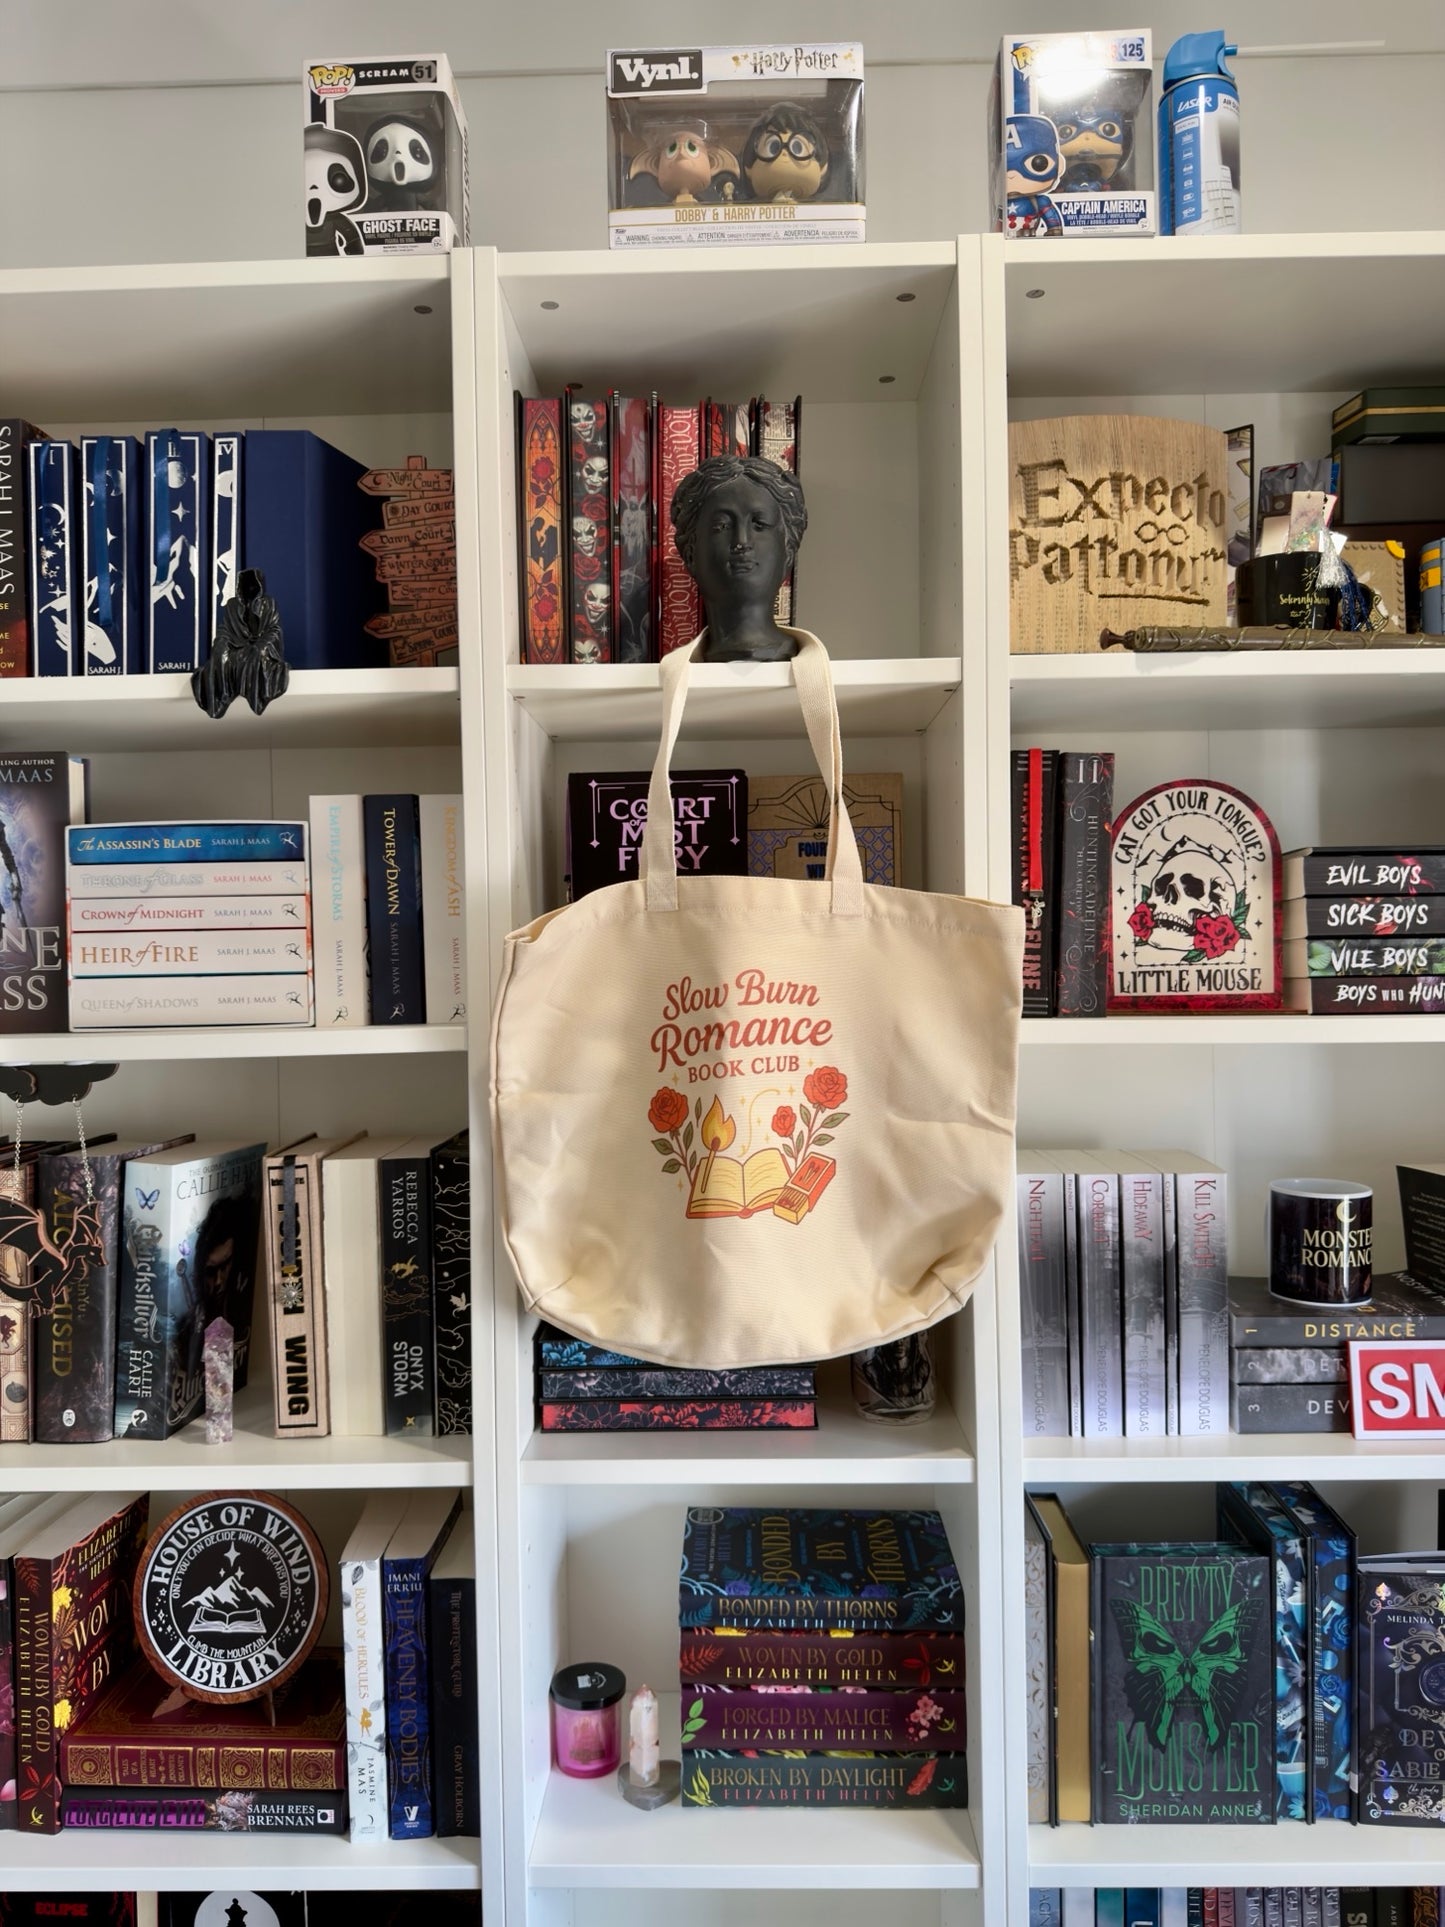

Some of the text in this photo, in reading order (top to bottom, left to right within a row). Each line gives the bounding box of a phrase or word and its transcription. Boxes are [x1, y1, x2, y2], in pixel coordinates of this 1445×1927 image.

[751, 48, 839, 76] Harry Potter
[1122, 43, 1143, 57] 125
[308, 65, 354, 87] POP!
[359, 68, 409, 78] SCREAM
[415, 65, 432, 78] 51
[616, 56, 699, 87] Vynl.
[675, 206, 796, 222] DOBBY & HARRY POTTER
[1061, 200, 1145, 214] CAPTAIN AMERICA
[363, 219, 437, 234] GHOST FACE
[388, 471, 413, 485] Night
[412, 477, 440, 490] Court
[415, 528, 444, 541] Court
[1279, 593, 1313, 605] Solemnly
[89, 666, 116, 675] SARAH
[158, 661, 186, 670] SARAH
[609, 797, 716, 820] CORT
[621, 820, 705, 846] MST
[1115, 790, 1266, 865] CAT GOT YOUR TONGUE?
[77, 838, 95, 852] The
[163, 838, 201, 849] BLADE
[211, 838, 240, 846] SARAH
[618, 845, 709, 871] FRY
[328, 806, 344, 921] EMPIRE STORMS
[383, 808, 400, 915] TOWER DAWN
[1326, 859, 1422, 891] EVIL BOYS
[213, 875, 240, 883] SARAH
[249, 875, 272, 883] MAAS
[1084, 815, 1099, 953] HUNTING ADELINE
[81, 909, 126, 921] CROWN
[140, 908, 205, 919] MIDNIGHT
[214, 909, 241, 917] SARAH
[448, 885, 461, 917] ASH
[1327, 903, 1428, 931] SICK BOYS
[81, 946, 132, 964] HEIR
[131, 941, 156, 967] of
[152, 945, 199, 963] FIRE
[217, 948, 244, 956] SARAH
[1331, 944, 1428, 974] VILE BOYS
[663, 969, 820, 1021] Slow Burn
[1118, 968, 1262, 994] LITTLE MOUSE
[81, 996, 277, 1012] QUEEN SHADOWS SARAH MAAS
[1333, 984, 1404, 1007] BOYS WHO
[651, 1017, 833, 1073] Romance
[688, 1055, 800, 1083] BOOK CLUB
[177, 1170, 227, 1200] CALLIE
[1194, 1180, 1216, 1209] KILL
[392, 1178, 406, 1239] YARROS
[406, 1171, 419, 1245] REBECCA
[1133, 1180, 1153, 1242] HIDEAWAY
[1304, 1323, 1416, 1338] DISTANCE
[128, 1349, 142, 1397] HART
[142, 1350, 153, 1398] CALLIE
[285, 1335, 310, 1416] WING
[393, 1340, 408, 1397] STORM
[409, 1346, 424, 1391] ONYX
[1199, 1343, 1211, 1387] PENELOPE
[1097, 1390, 1107, 1432] DOUGLAS
[1138, 1389, 1149, 1432] DOUGLAS
[78, 1517, 132, 1567] ELIZABETH
[151, 1511, 215, 1585] HOUSE
[220, 1506, 255, 1526] OF
[263, 1513, 312, 1585] WIND
[761, 1516, 801, 1583] BONDED
[815, 1538, 847, 1561] BY
[865, 1517, 907, 1585] THORNS
[172, 1531, 289, 1600] ONLY YOU CAN DECIDE WHAT BREAKS YOU
[388, 1573, 421, 1583] IMANI
[1139, 1559, 1236, 1622] PRETTY
[719, 1598, 898, 1618] BONDED BY THORNS
[1386, 1615, 1435, 1626] MELINDA
[187, 1634, 267, 1660] CLIMB THE MOUNTAIN
[353, 1587, 370, 1700] BLOOD HERCULES
[738, 1646, 884, 1666] WOVEN BY GOLD
[92, 1649, 112, 1692] BY
[166, 1639, 287, 1689] LIBRARY
[726, 1666, 898, 1682] ELIZABETH HELEN
[19, 1596, 32, 1764] ELIZABETH HELEN
[34, 1611, 51, 1753] WOVEN BY GOLD
[396, 1598, 420, 1787] HEAVENLY BODIES
[723, 1707, 891, 1726] FORGED BY MALICE
[722, 1728, 893, 1741] ELIZABETH HELEN
[357, 1767, 367, 1795] MAS
[367, 1756, 376, 1803] JASMINE
[711, 1767, 908, 1786] BROKEN BY DAYLIGHT
[1375, 1759, 1442, 1780] SABLE
[453, 1745, 465, 1828] GRAY HOLBORN
[724, 1788, 896, 1801] ELIZABETH HELEN
[247, 1804, 315, 1814] SARAH REES
[248, 1814, 315, 1826] BRENNAN
[1119, 1803, 1255, 1817] SHERIDAN ANNE
[34, 1901, 88, 1918] ECLIPSE
